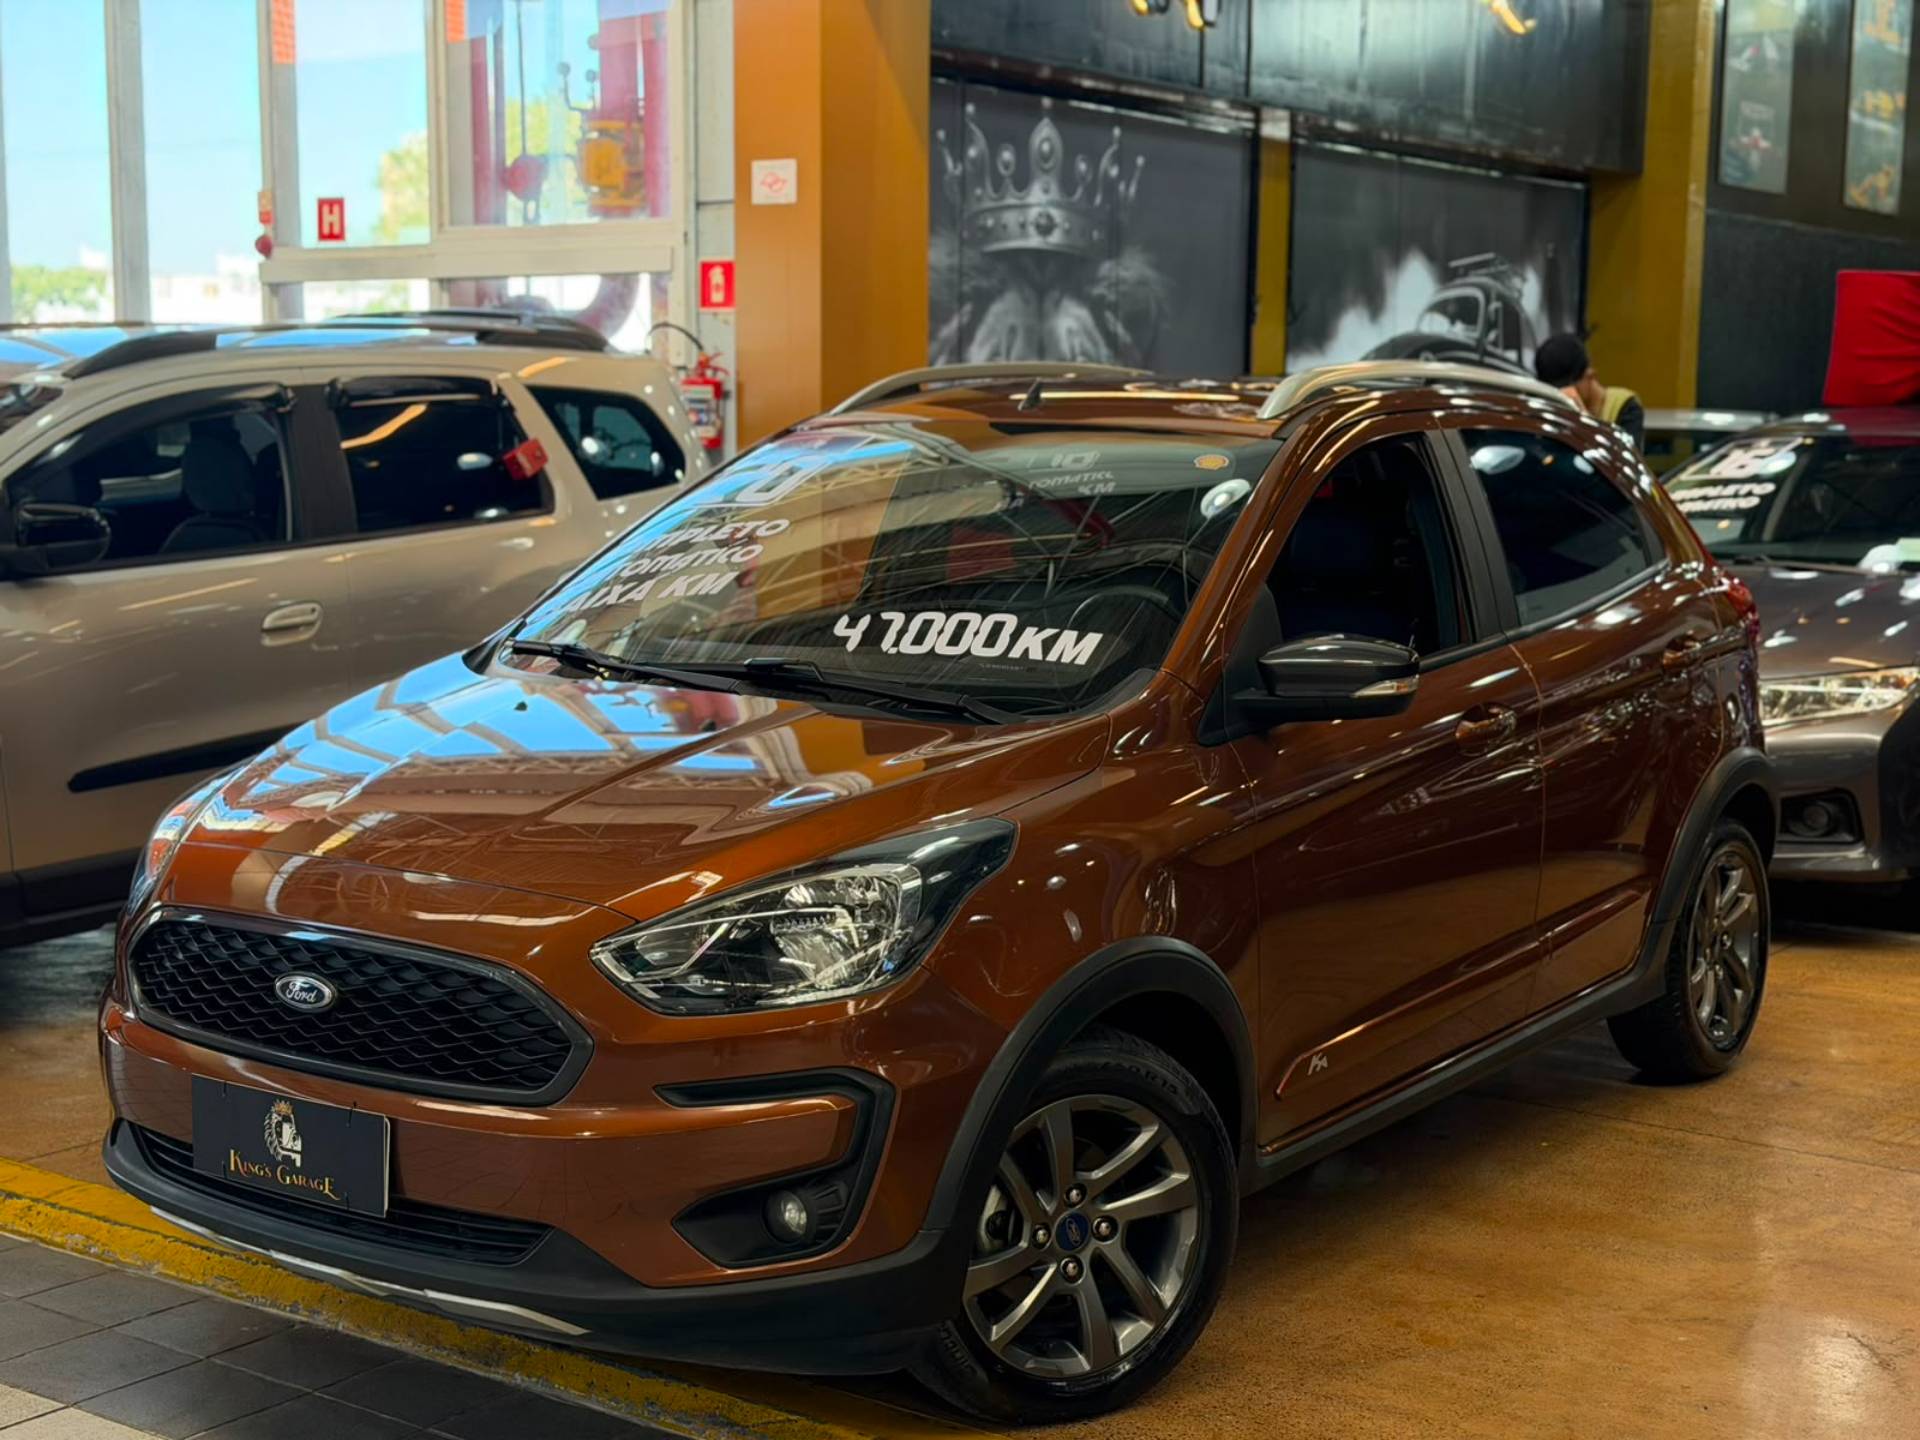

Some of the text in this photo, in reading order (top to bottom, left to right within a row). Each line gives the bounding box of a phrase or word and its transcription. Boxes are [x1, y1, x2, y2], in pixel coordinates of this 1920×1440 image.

[321, 203, 341, 235] H
[645, 519, 790, 550] MPLETO
[562, 571, 740, 613] AIXA KM
